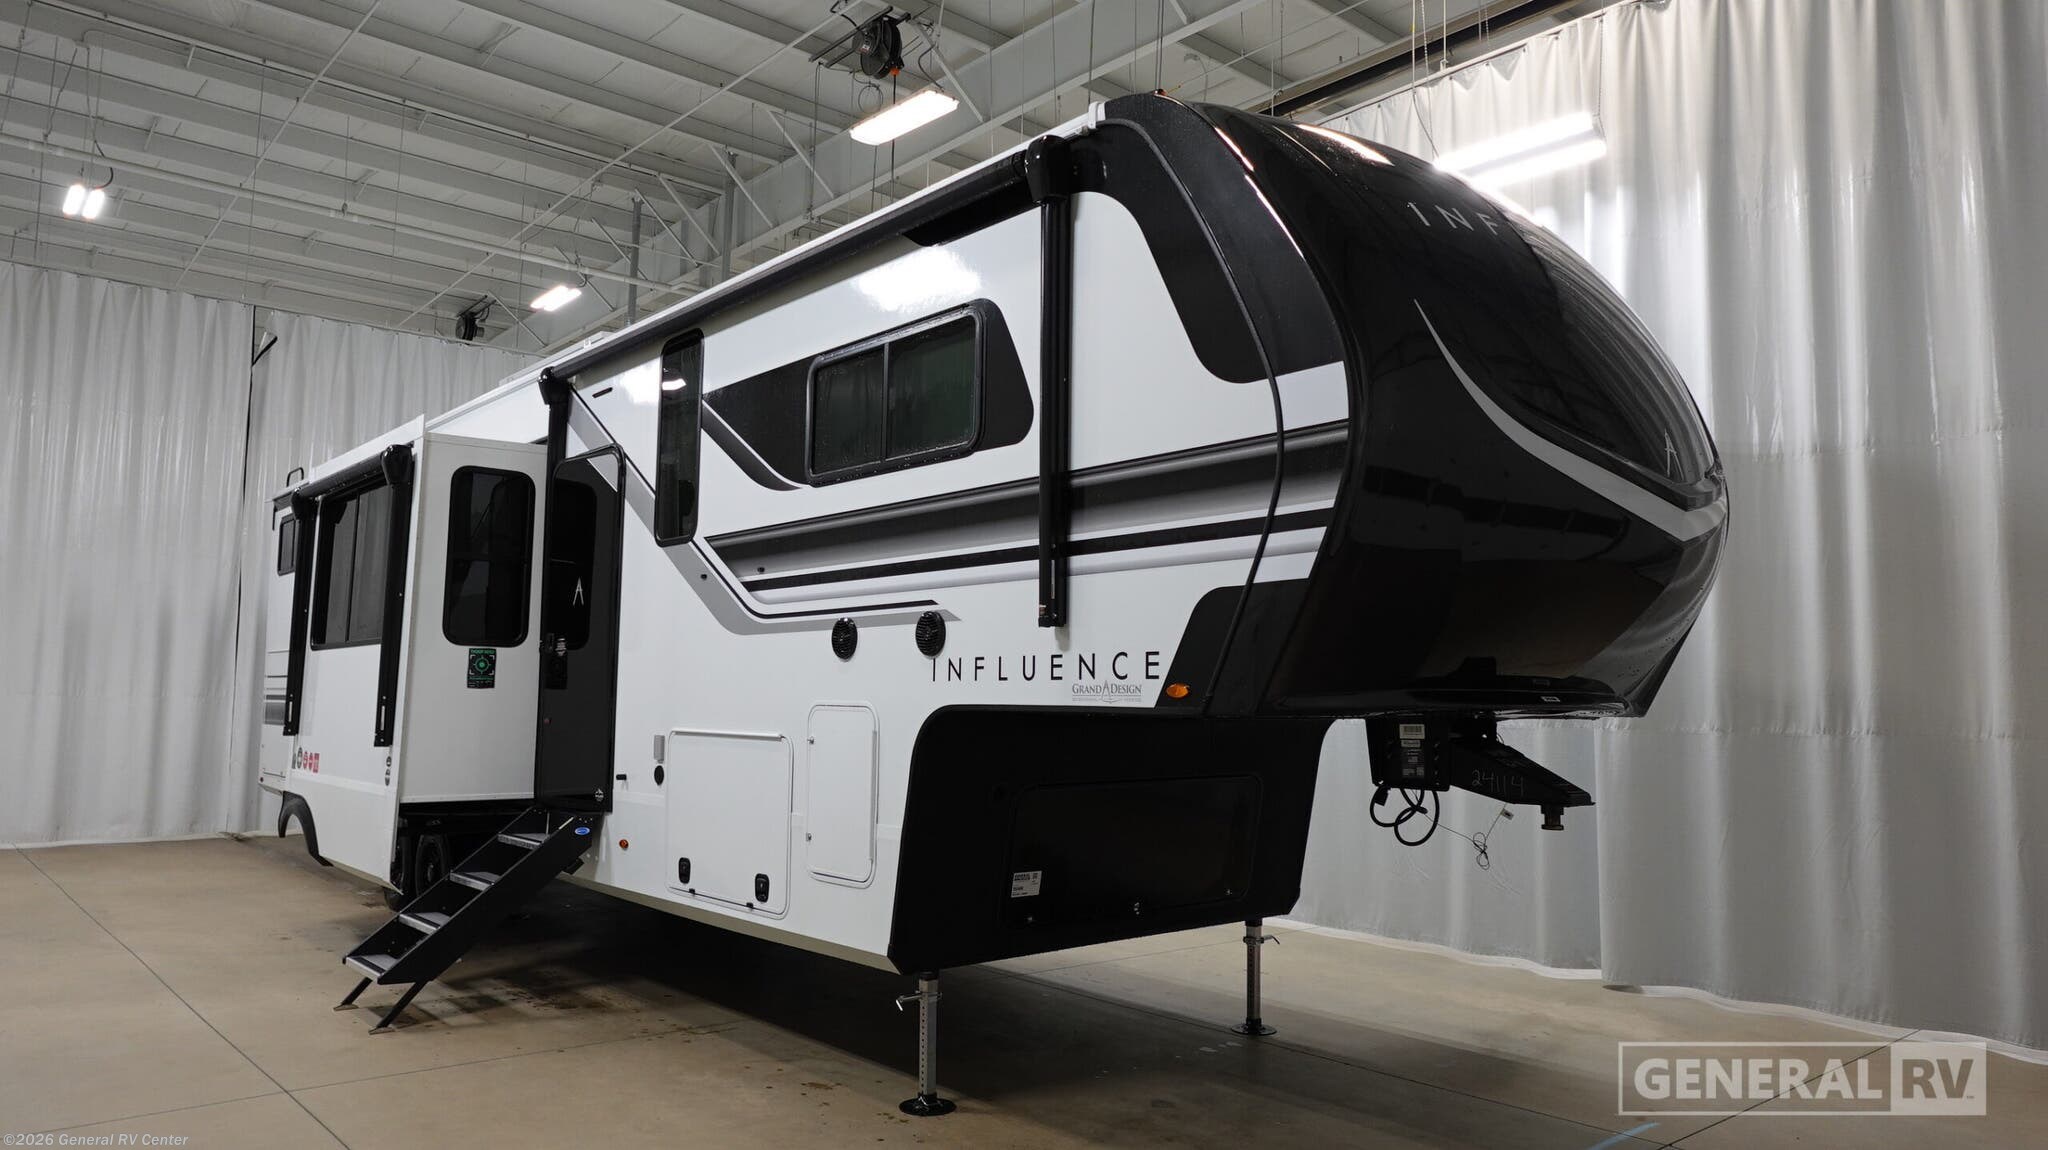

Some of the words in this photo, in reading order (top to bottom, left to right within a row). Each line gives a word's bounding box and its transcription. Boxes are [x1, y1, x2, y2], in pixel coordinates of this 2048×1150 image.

[932, 651, 1160, 682] INFLUENCE
[1072, 683, 1102, 694] GRAND
[1110, 683, 1141, 694] DESIGN
